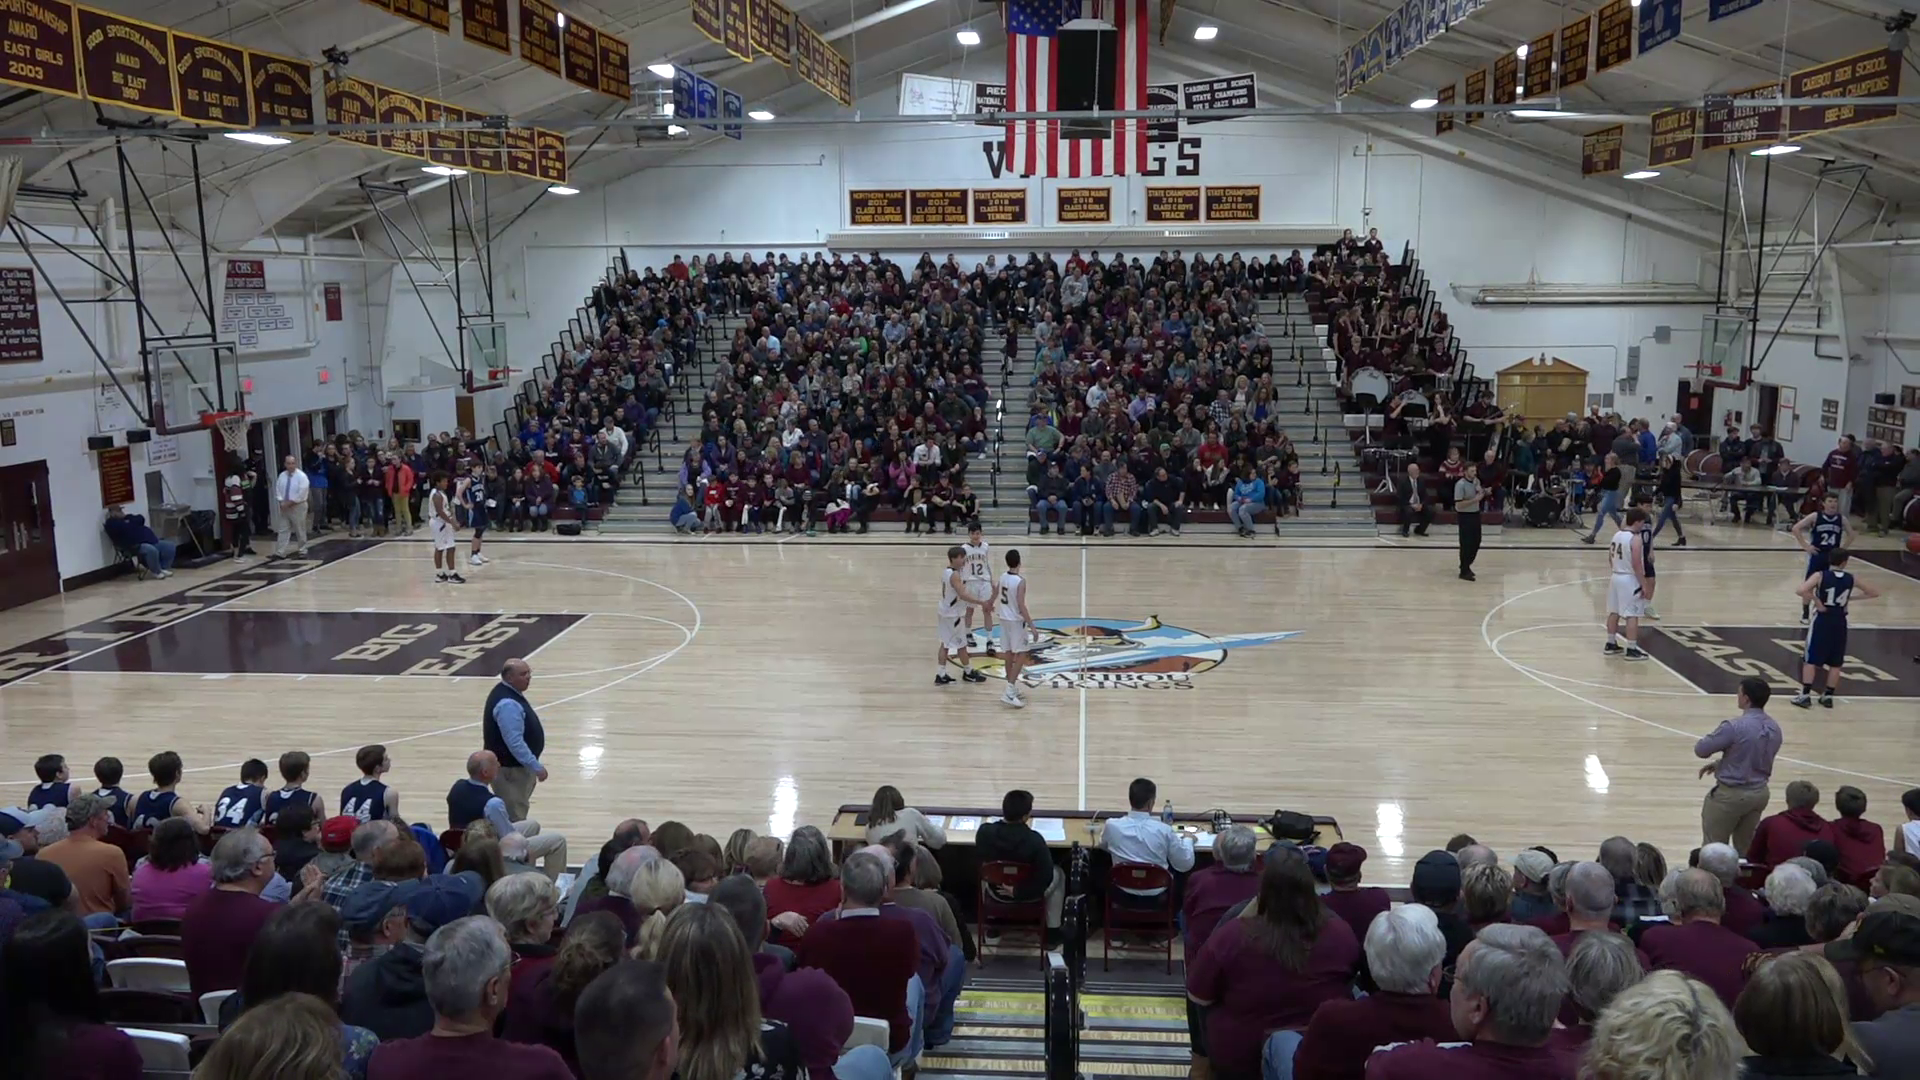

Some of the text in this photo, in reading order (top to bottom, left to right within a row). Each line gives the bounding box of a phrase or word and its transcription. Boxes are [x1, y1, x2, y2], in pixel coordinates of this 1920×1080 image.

[8, 19, 37, 40] AWARD
[4, 40, 63, 66] EAST GIRLS
[116, 52, 140, 69] AWARD
[9, 61, 43, 80] 2003
[1801, 56, 1887, 92] CARIBOU HIGH SCHOOL
[111, 71, 147, 90] BIG EAST
[1185, 78, 1253, 93] CARIBOU HIGH SCHOOL
[1845, 76, 1889, 98] CHAMPIONS
[203, 91, 220, 105] EAST
[1192, 88, 1247, 102] STATE CHAMPIONS
[1232, 97, 1248, 106] BAND
[274, 104, 288, 116] EAST
[1710, 109, 1728, 122] STATE
[1722, 116, 1759, 133] CHAMPIONS
[1211, 210, 1255, 218] BASKETBALL
[236, 262, 251, 274] CHS
[1820, 532, 1837, 545] 24
[971, 563, 983, 576] 12
[1000, 586, 1009, 605] 5
[1824, 586, 1850, 607] 14
[331, 623, 438, 662] BIG
[400, 612, 540, 677] EAST
[1020, 672, 1191, 682] CARIBOU
[1021, 680, 1195, 690] VIKINGS
[215, 797, 248, 825] 34
